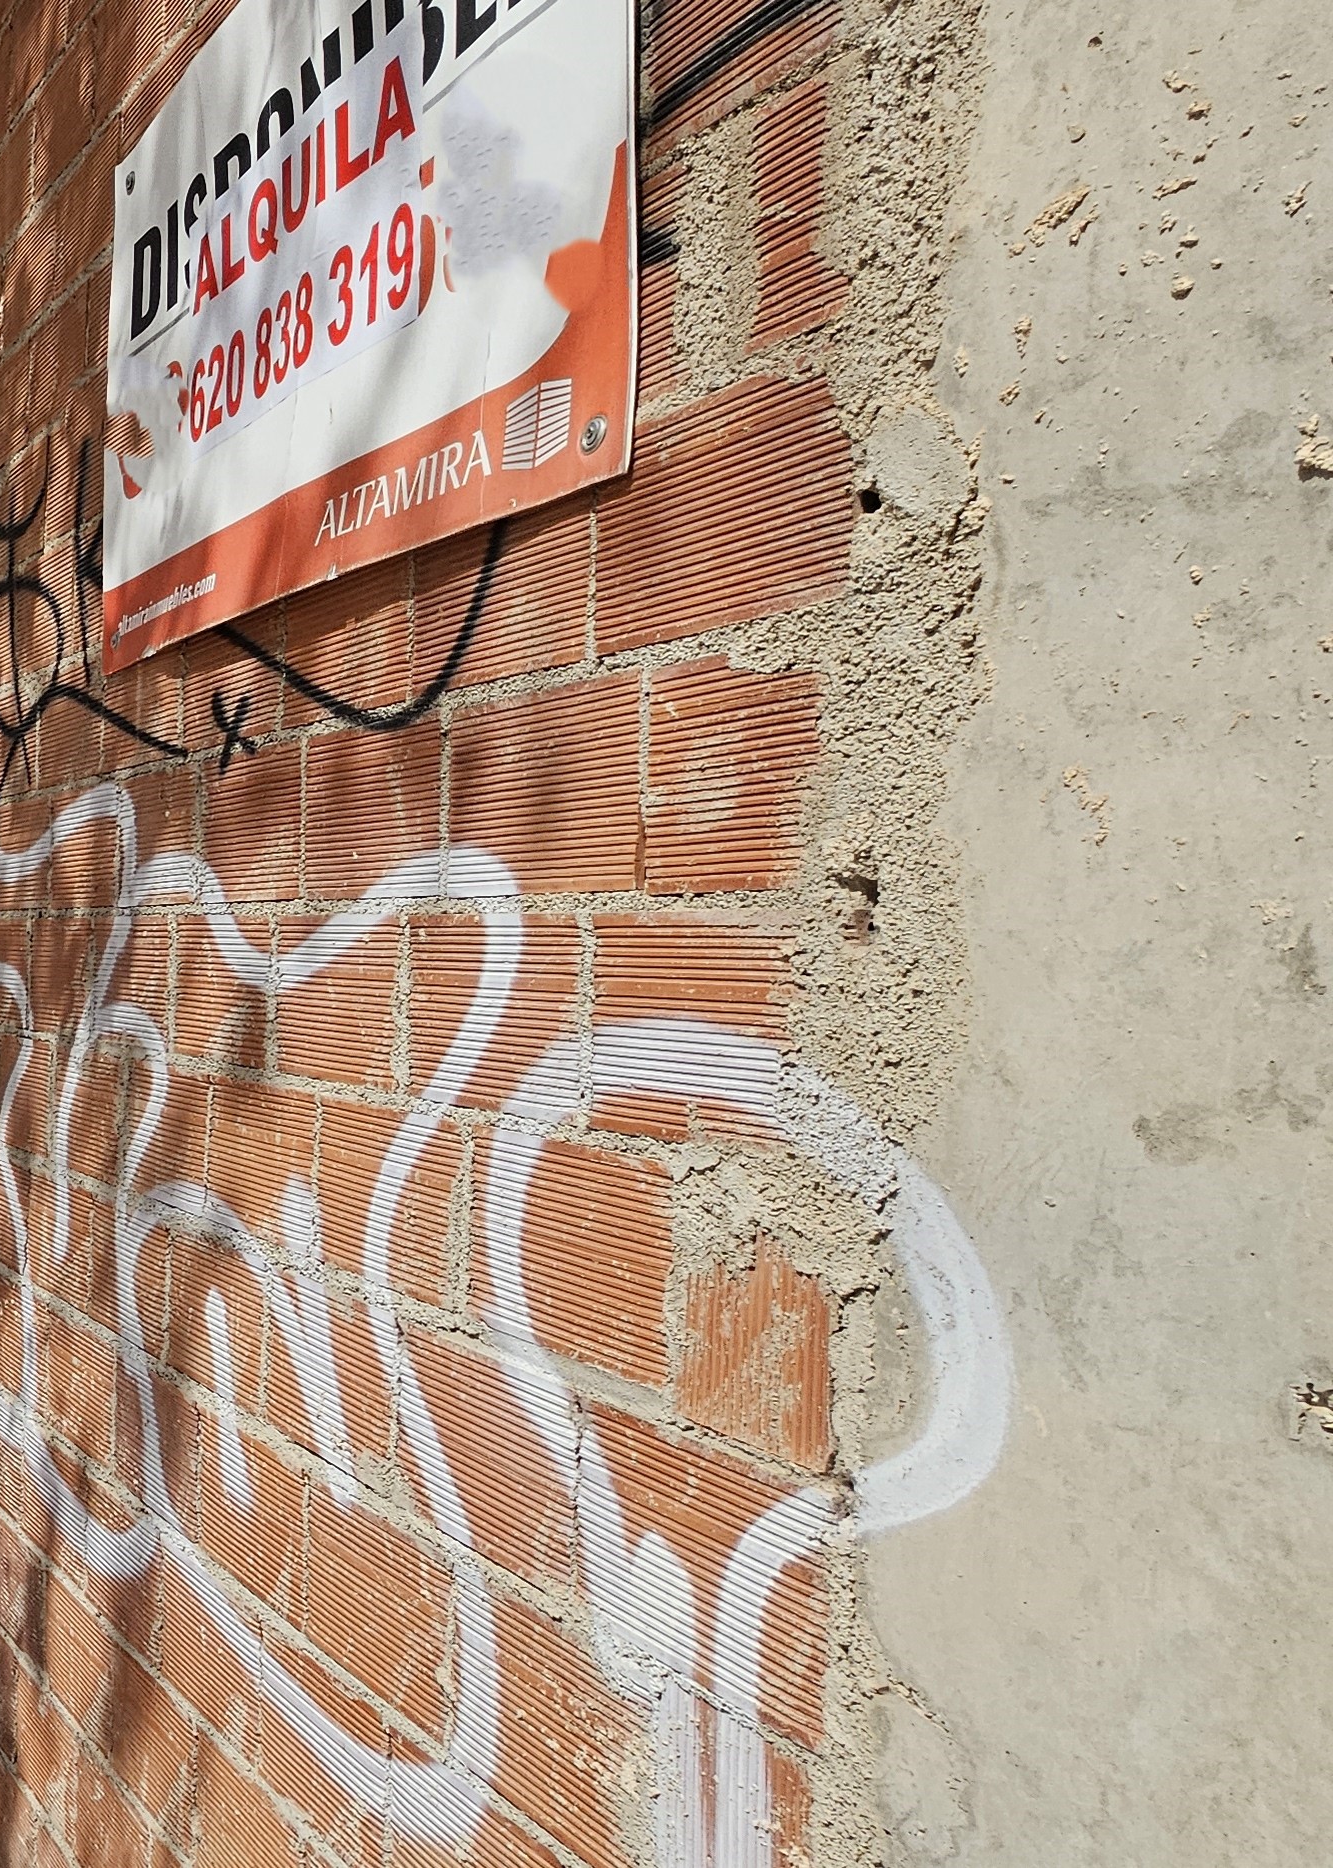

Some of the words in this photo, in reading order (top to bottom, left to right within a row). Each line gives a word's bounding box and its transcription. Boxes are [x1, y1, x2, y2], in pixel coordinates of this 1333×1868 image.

[192, 56, 416, 317] ALQUILA
[190, 329, 245, 443] 620
[253, 271, 313, 400] 838
[328, 202, 414, 346] 319
[314, 430, 492, 547] ALTAMIRA
